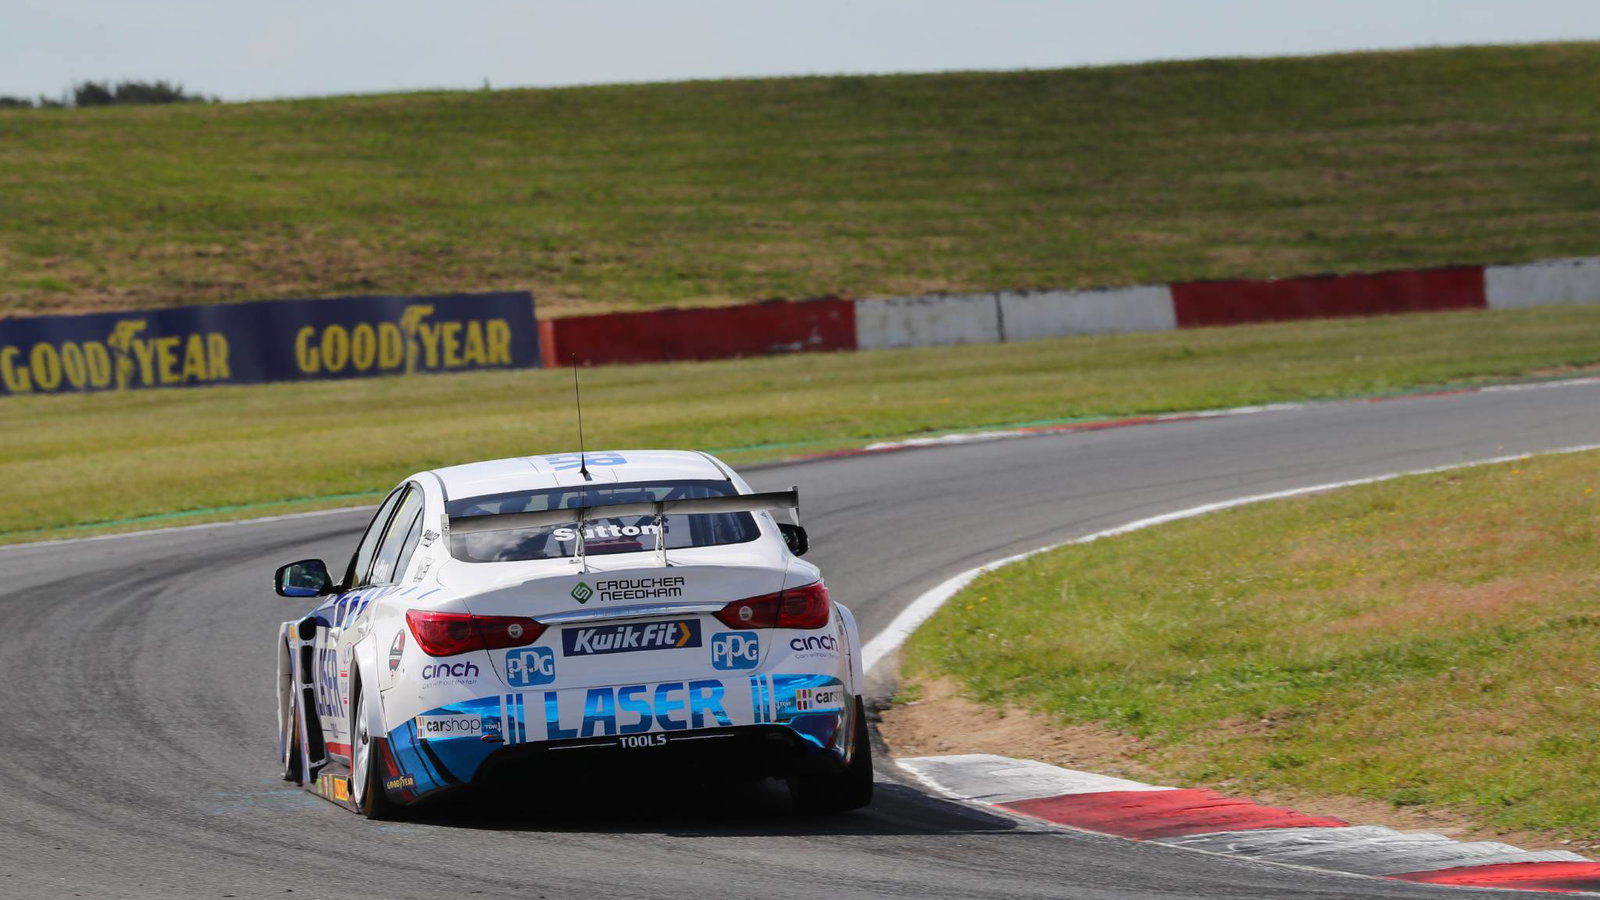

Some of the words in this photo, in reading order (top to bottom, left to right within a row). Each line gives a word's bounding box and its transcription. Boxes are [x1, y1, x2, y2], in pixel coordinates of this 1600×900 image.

[553, 523, 659, 542] Sutton
[596, 576, 685, 591] CROUCHER
[600, 587, 682, 601] NEEDHAM
[713, 635, 757, 667] PPG
[790, 633, 838, 652] cinch
[422, 661, 479, 680] cinch
[507, 650, 553, 683] PPG
[544, 679, 733, 739] LASER
[427, 717, 481, 734] carshop
[619, 733, 667, 748] TOOLS
